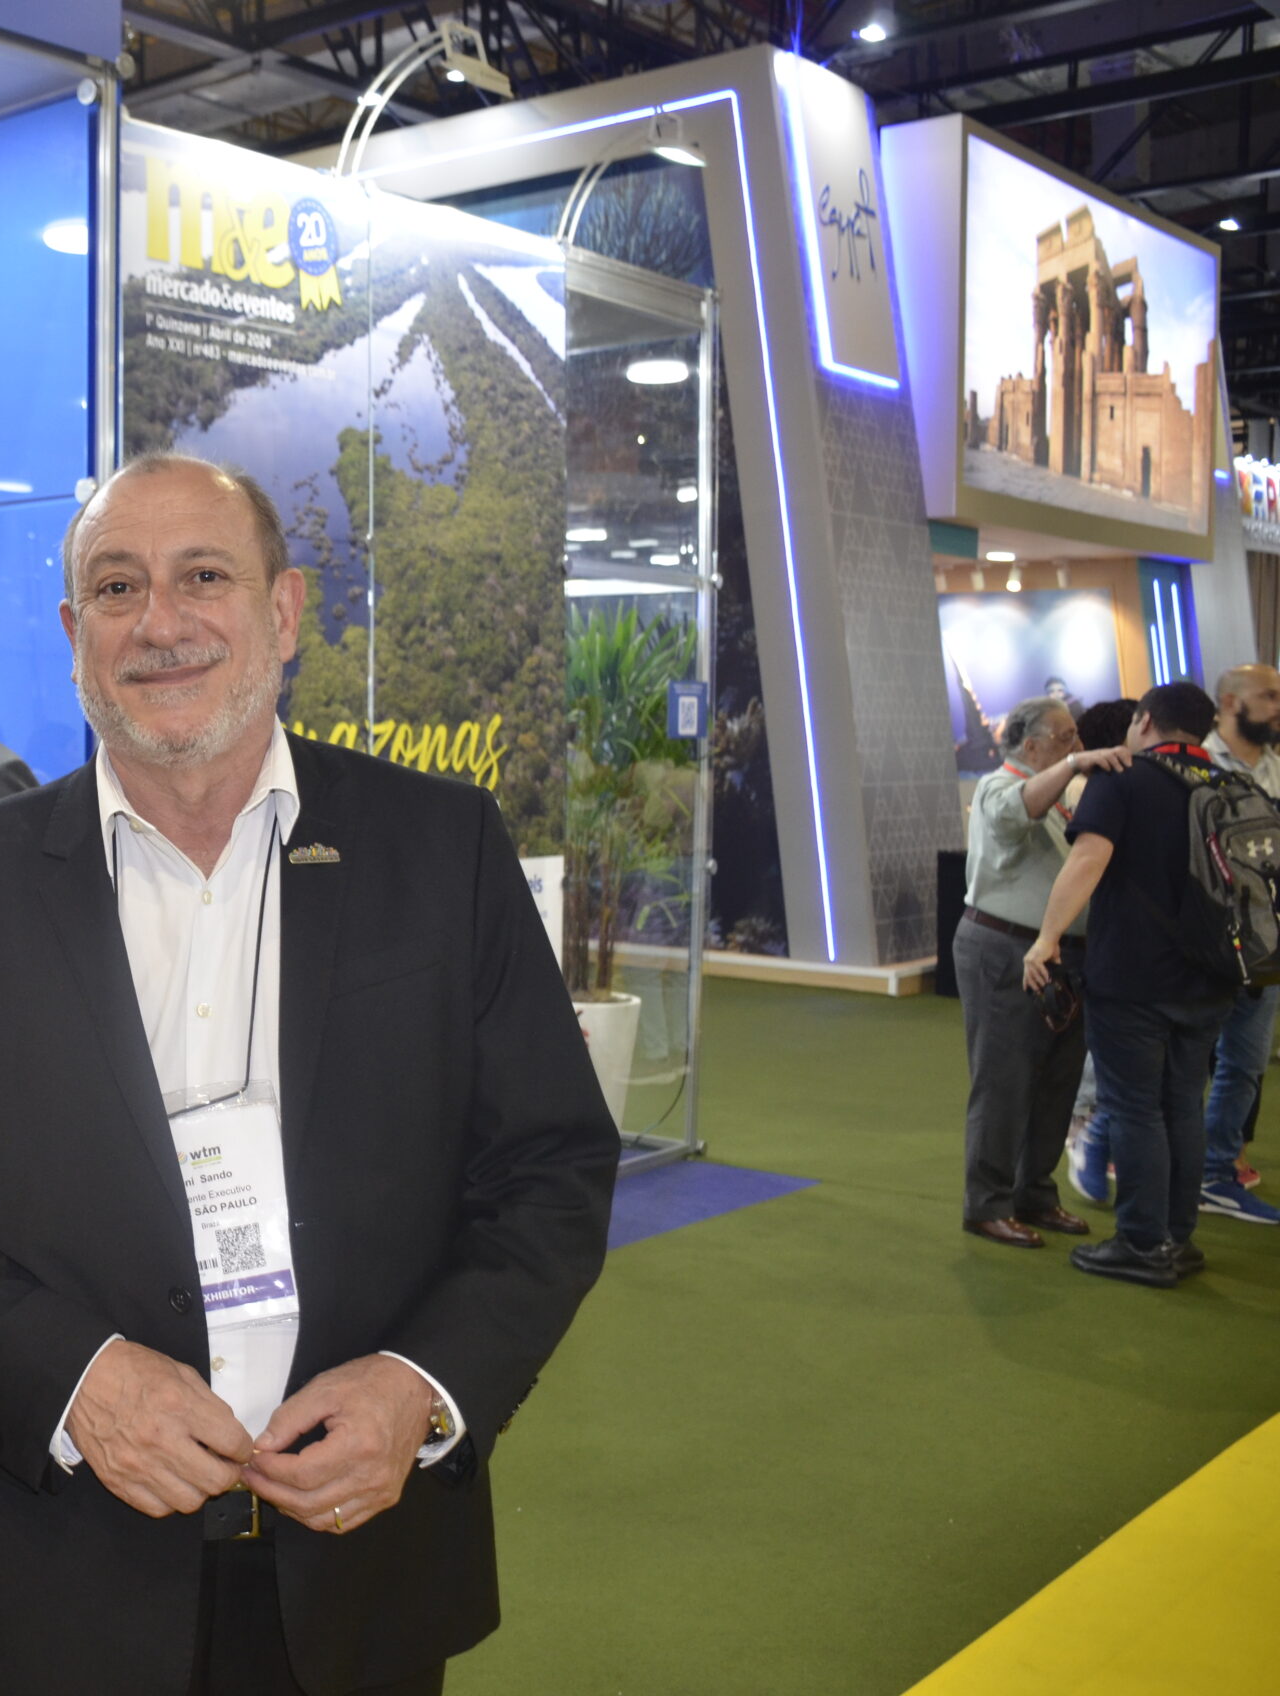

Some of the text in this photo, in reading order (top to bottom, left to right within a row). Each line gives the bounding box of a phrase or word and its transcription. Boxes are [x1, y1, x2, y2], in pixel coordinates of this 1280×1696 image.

[297, 211, 327, 247] 20
[146, 273, 296, 324] mercado&eventos
[156, 314, 201, 337] Quinzena
[209, 324, 232, 343] Abril
[233, 329, 246, 345] de
[247, 331, 272, 350] 2024
[146, 333, 166, 350] Ano
[190, 1145, 221, 1160] wtm
[200, 1170, 233, 1184] Sando
[208, 1184, 252, 1199] Executivo
[220, 1196, 257, 1212] PAULO
[204, 1286, 255, 1303] XHIBITOR
